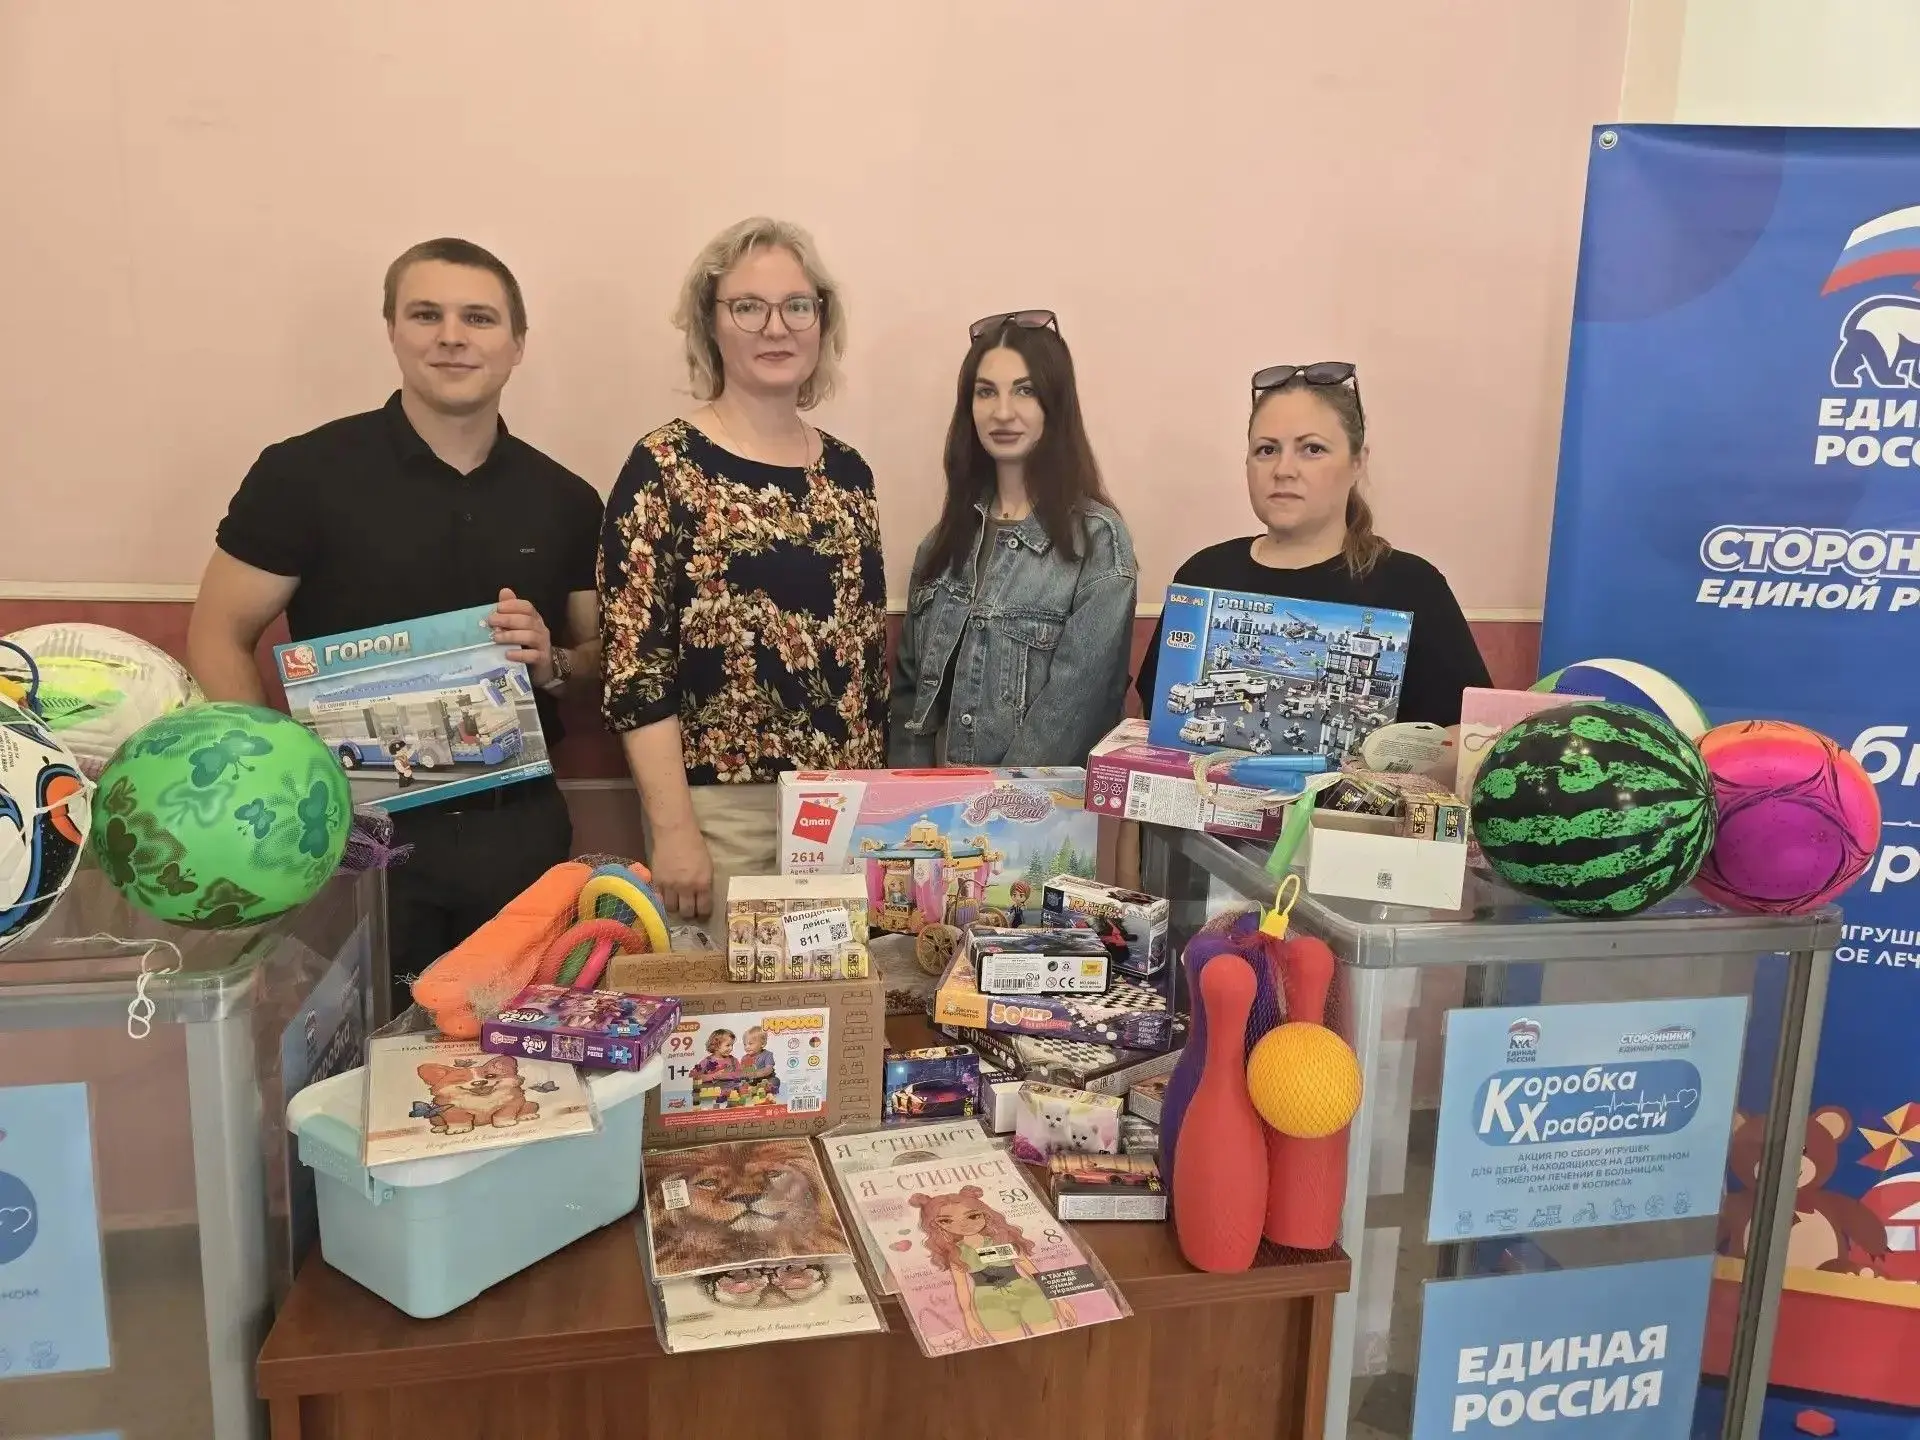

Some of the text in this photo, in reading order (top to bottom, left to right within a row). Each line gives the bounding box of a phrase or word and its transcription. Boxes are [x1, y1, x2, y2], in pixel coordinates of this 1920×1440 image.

[1818, 398, 1920, 431] ЕДИ
[1696, 577, 1882, 610] ЕДИНОЙ
[1217, 597, 1275, 614] POLICE
[1171, 631, 1190, 642] 193
[324, 631, 411, 666] ГОРОД
[800, 817, 831, 827] Qman
[791, 852, 825, 863] 2614
[803, 917, 831, 930] дейск
[800, 934, 820, 947] 811
[990, 1002, 1022, 1026] 50
[676, 1023, 699, 1032] auer
[669, 1036, 694, 1052] 99
[667, 1052, 695, 1060] деталей
[668, 1065, 690, 1080] 1+
[1479, 1067, 1638, 1134] Коробка
[1509, 1102, 1668, 1144] Храбрости
[836, 1143, 852, 1159] Я
[871, 1128, 975, 1153] СТИЛИСТ
[1518, 1144, 1650, 1162] АКЦИЯ ПО СБОРУ ИГРУШЕК
[1471, 1167, 1493, 1177] ДЛЯ
[1531, 1158, 1607, 1172] НАХОДЯЩИХСЯ
[1609, 1157, 1623, 1166] НА
[1624, 1151, 1690, 1165] ДЛИТЕЛЬНОМ
[860, 1180, 878, 1197] Я
[897, 1160, 1007, 1190] СТИЛИСТ
[1547, 1170, 1594, 1181] ЛЕЧЕНИИ
[1537, 1181, 1570, 1193] ТАКЖЕ
[1582, 1178, 1633, 1190] ХОСПИСАХ
[999, 1188, 1029, 1204] 59
[1043, 1229, 1063, 1243] 8
[1457, 1324, 1668, 1385] ЕДИНАЯ
[1452, 1370, 1663, 1432] РОССИЯ
